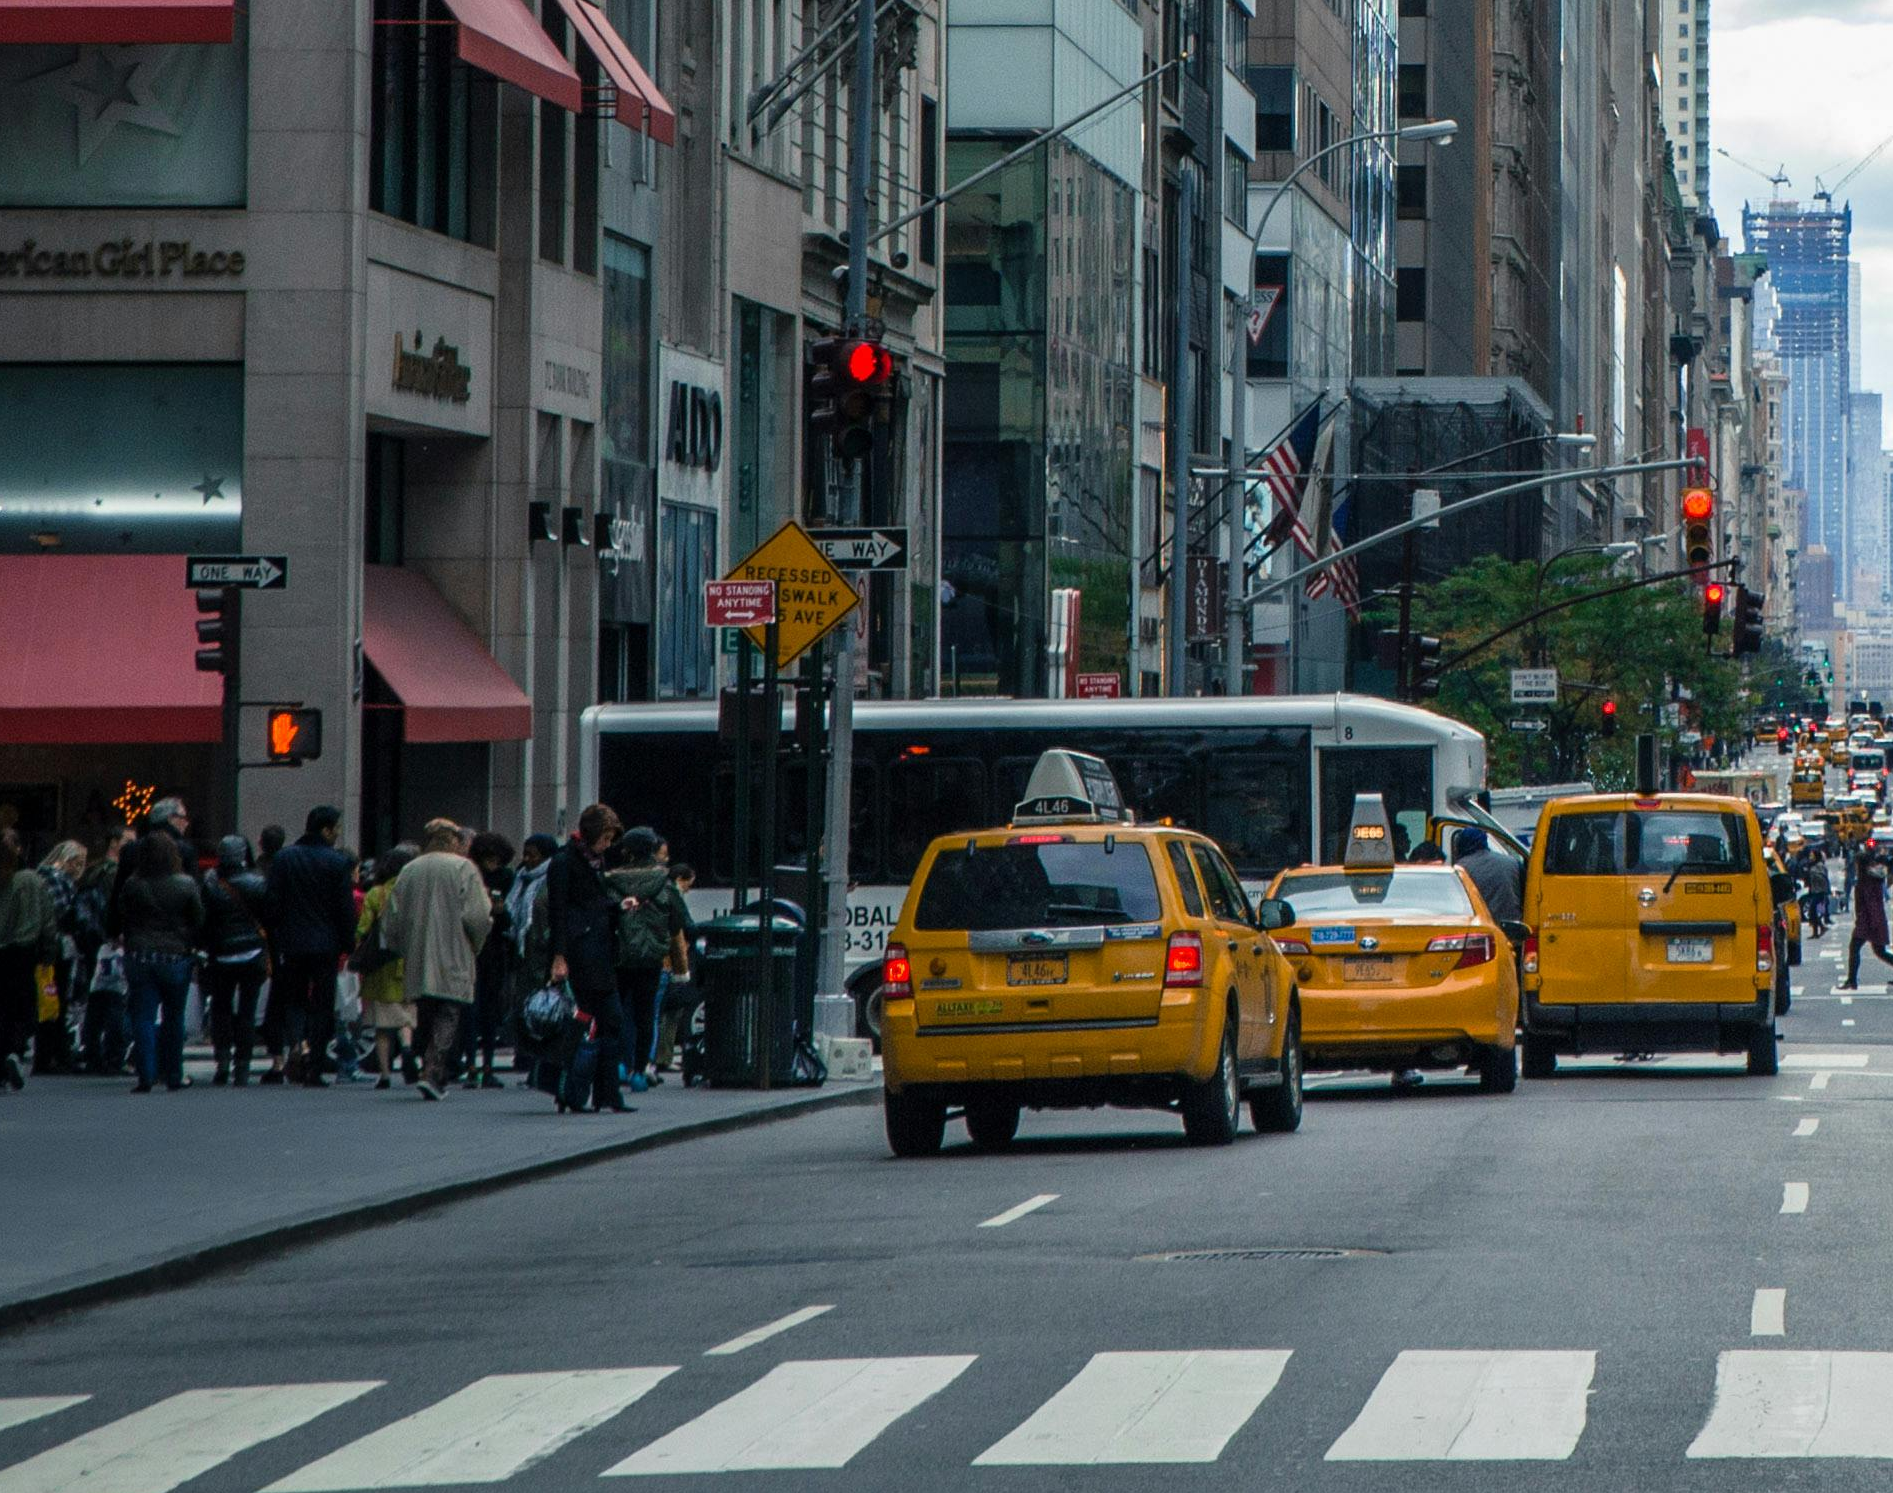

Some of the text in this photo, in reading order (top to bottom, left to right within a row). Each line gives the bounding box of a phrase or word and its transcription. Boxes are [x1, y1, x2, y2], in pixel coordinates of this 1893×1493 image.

[95, 237, 154, 276] Girl
[159, 241, 245, 276] Place
[666, 380, 723, 474] ALDO
[852, 542, 889, 558] WAY
[201, 566, 272, 580] ONE WAY
[745, 566, 832, 585] RECESSED
[709, 584, 770, 596] NO STANDING
[717, 597, 763, 609] ANYTIME
[792, 610, 825, 626] AVE
[1084, 686, 1112, 694] ANYTIME
[1345, 726, 1353, 740] 8
[1035, 799, 1069, 813] 4L46
